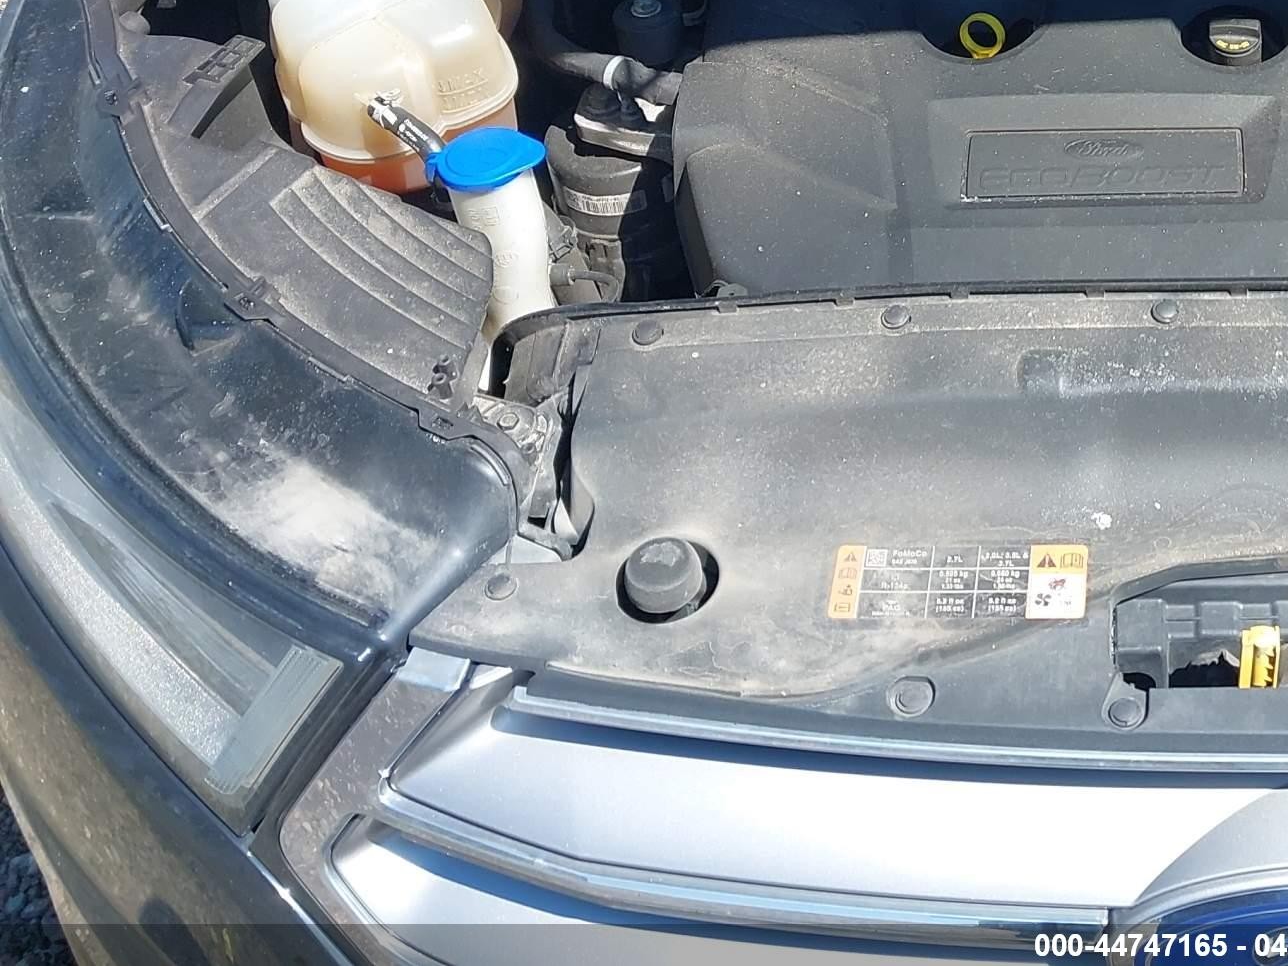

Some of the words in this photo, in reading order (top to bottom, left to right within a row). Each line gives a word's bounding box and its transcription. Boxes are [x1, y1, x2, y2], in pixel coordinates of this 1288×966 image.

[1078, 139, 1129, 156] Ford
[979, 165, 1227, 188] ECOBOOST
[892, 549, 928, 558] FoMoCo
